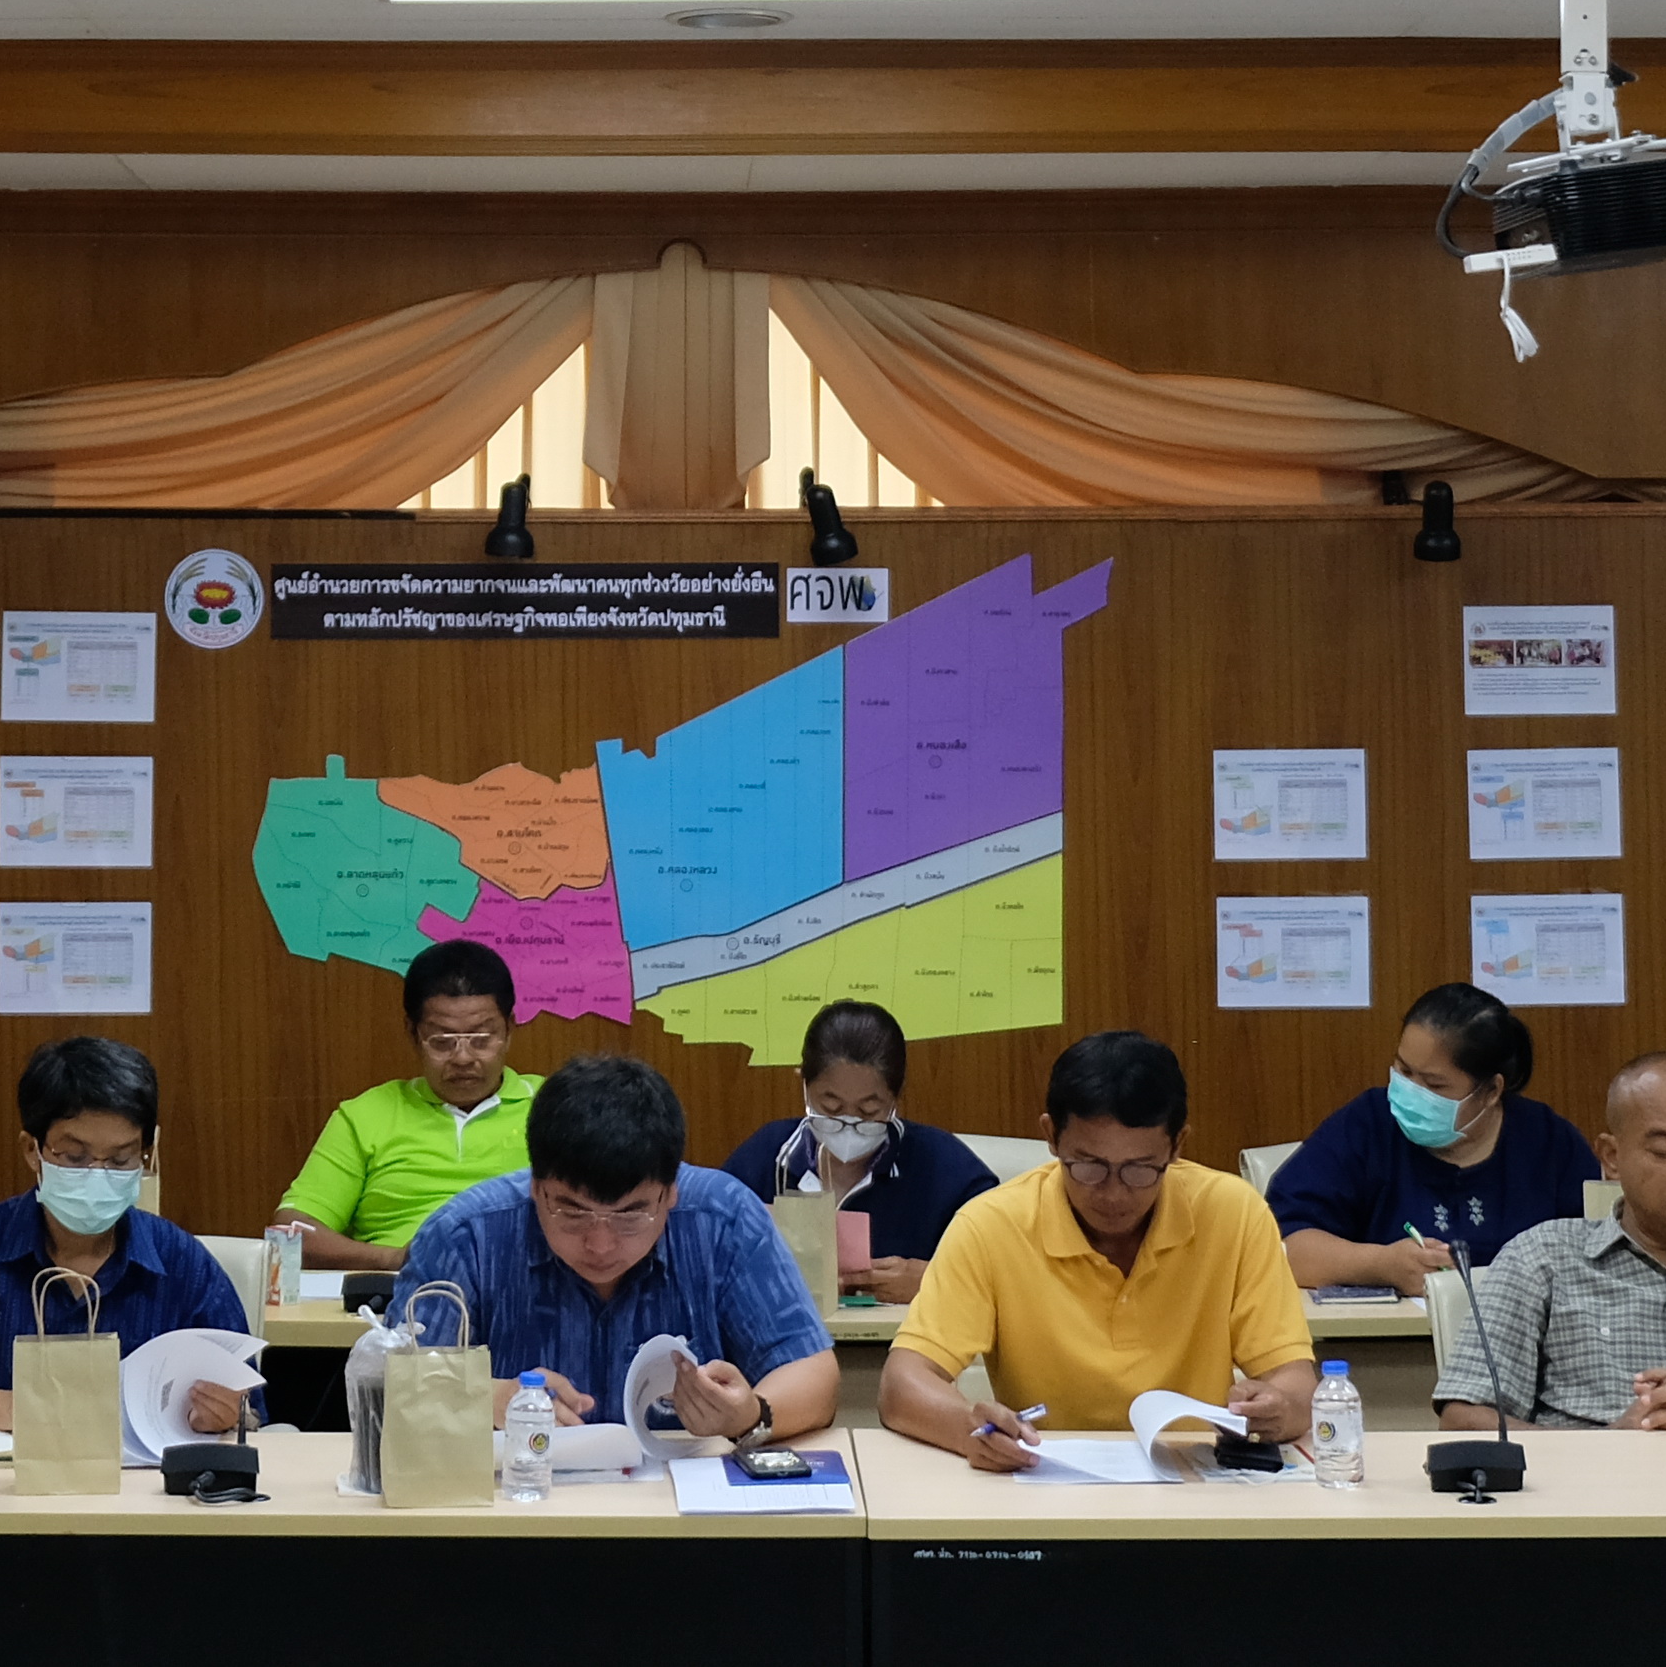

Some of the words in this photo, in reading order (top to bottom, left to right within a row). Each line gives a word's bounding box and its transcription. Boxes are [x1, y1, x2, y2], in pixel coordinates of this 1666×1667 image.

[273, 566, 775, 600] ศูนย์อำนวยการขจัดความยากจนและพัฒนาคนทุกช่วงวัยอย่างยั่งยืน
[789, 573, 865, 612] ศจพ
[323, 605, 726, 634] ตามหลักปรัชญาของเศรษฐกิจพอเพียงจังหวัดปทุมธานี
